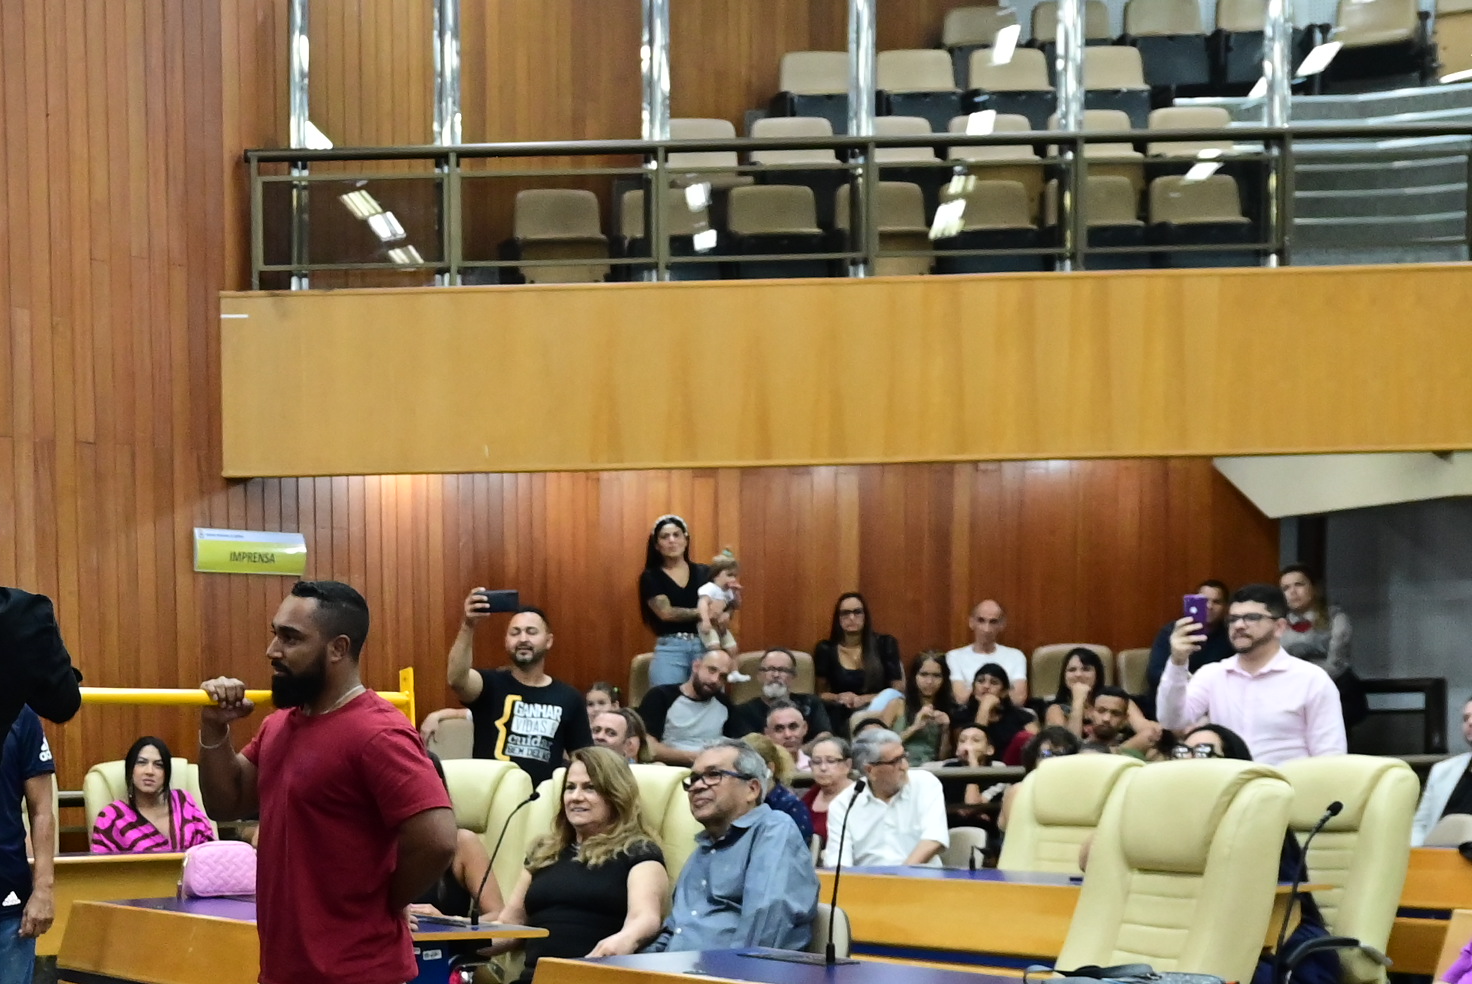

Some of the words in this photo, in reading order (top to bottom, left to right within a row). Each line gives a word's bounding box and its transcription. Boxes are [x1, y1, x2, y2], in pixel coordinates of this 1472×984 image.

[229, 551, 276, 564] IMPRENSA
[513, 701, 563, 722] GANHAR
[515, 718, 548, 734] VIDAS
